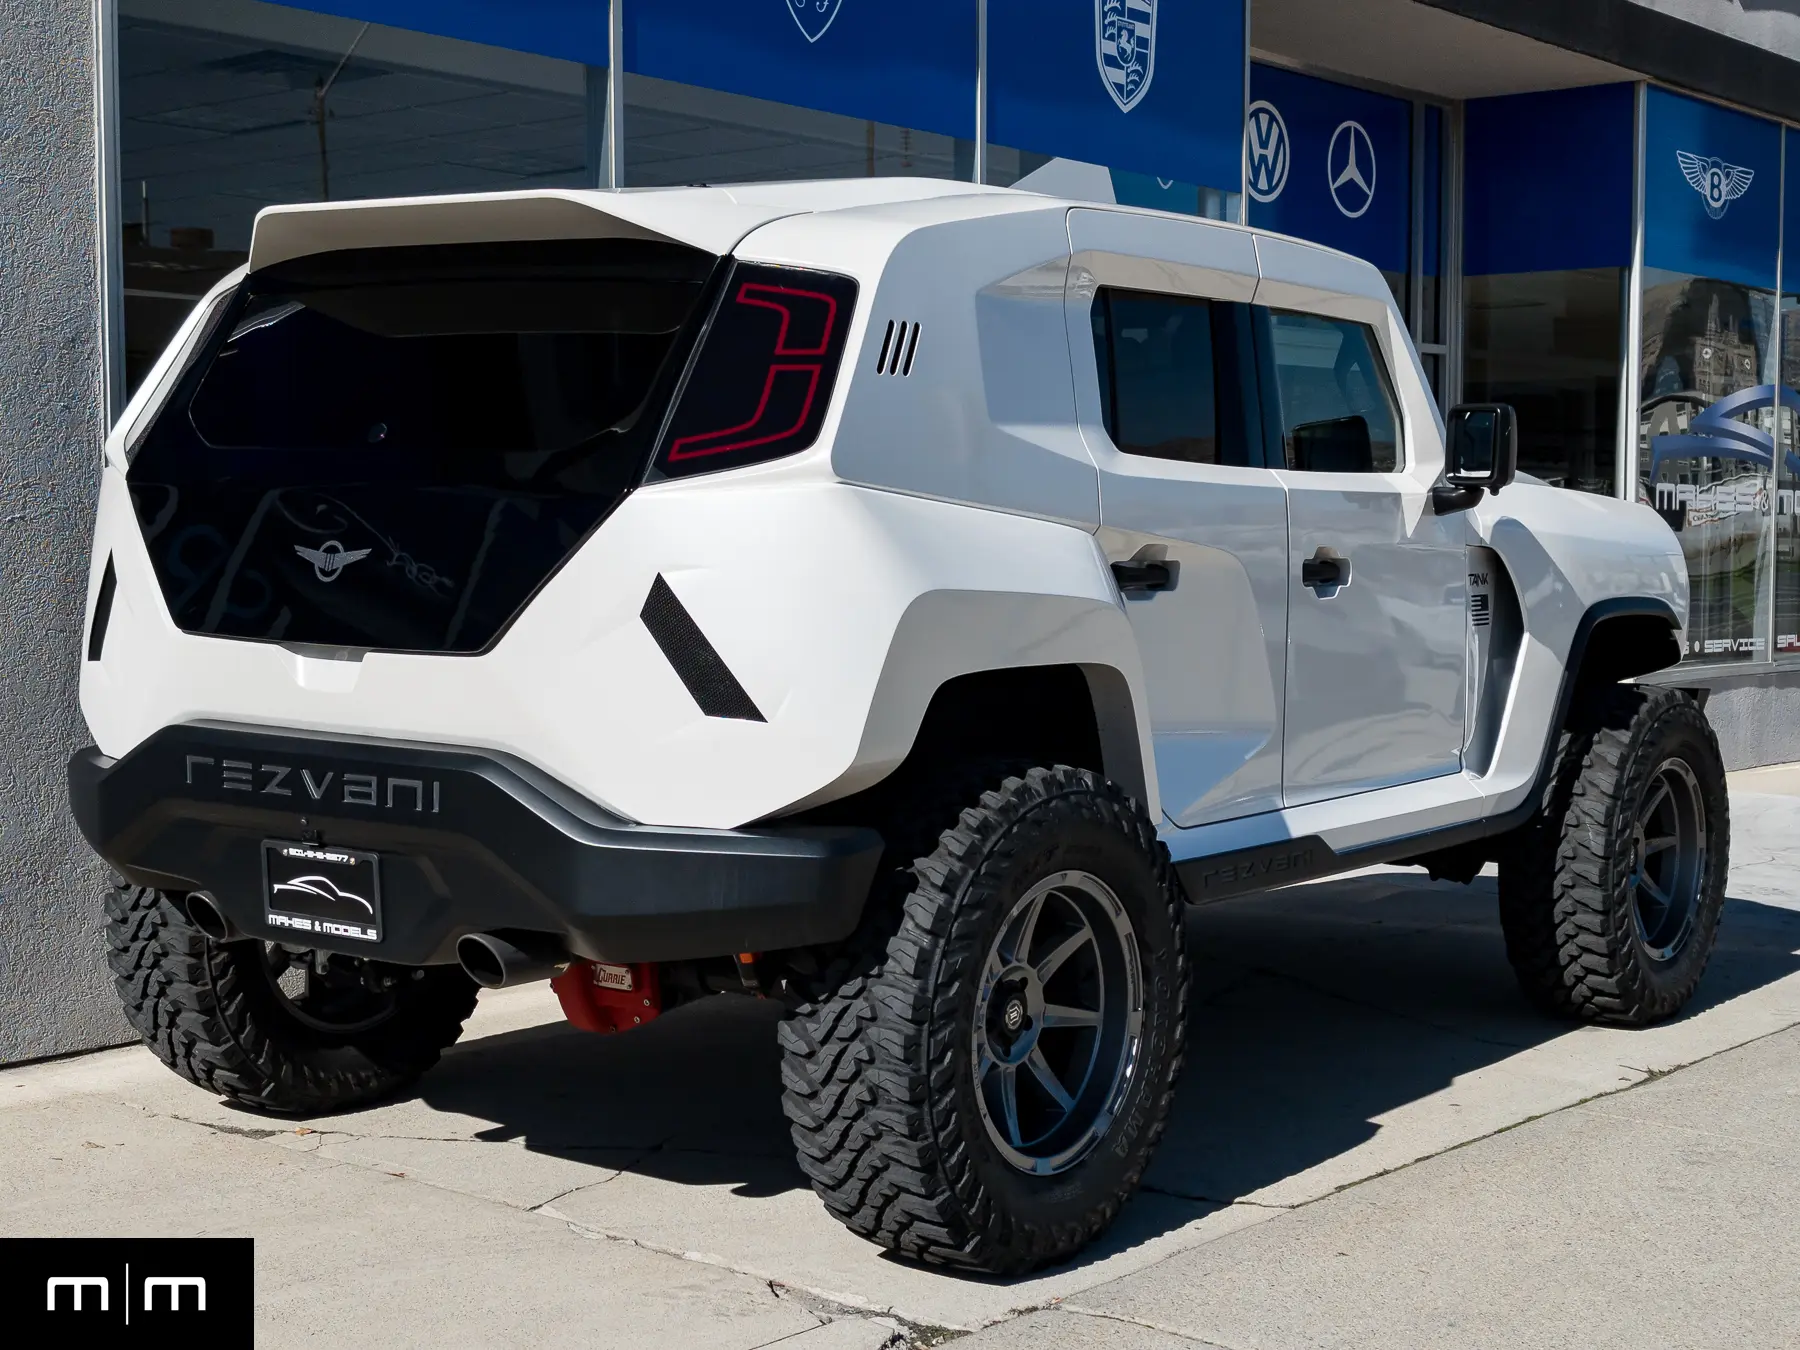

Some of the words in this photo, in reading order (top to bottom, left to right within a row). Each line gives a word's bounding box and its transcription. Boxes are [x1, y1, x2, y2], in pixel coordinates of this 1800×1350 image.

[1656, 483, 1756, 511] MAKES
[1468, 572, 1489, 587] TANK
[1704, 638, 1765, 653] SERVICE
[268, 914, 312, 931] MAKES
[314, 920, 321, 931] &
[323, 922, 377, 940] MODELS
[599, 968, 627, 985] CURRIE
